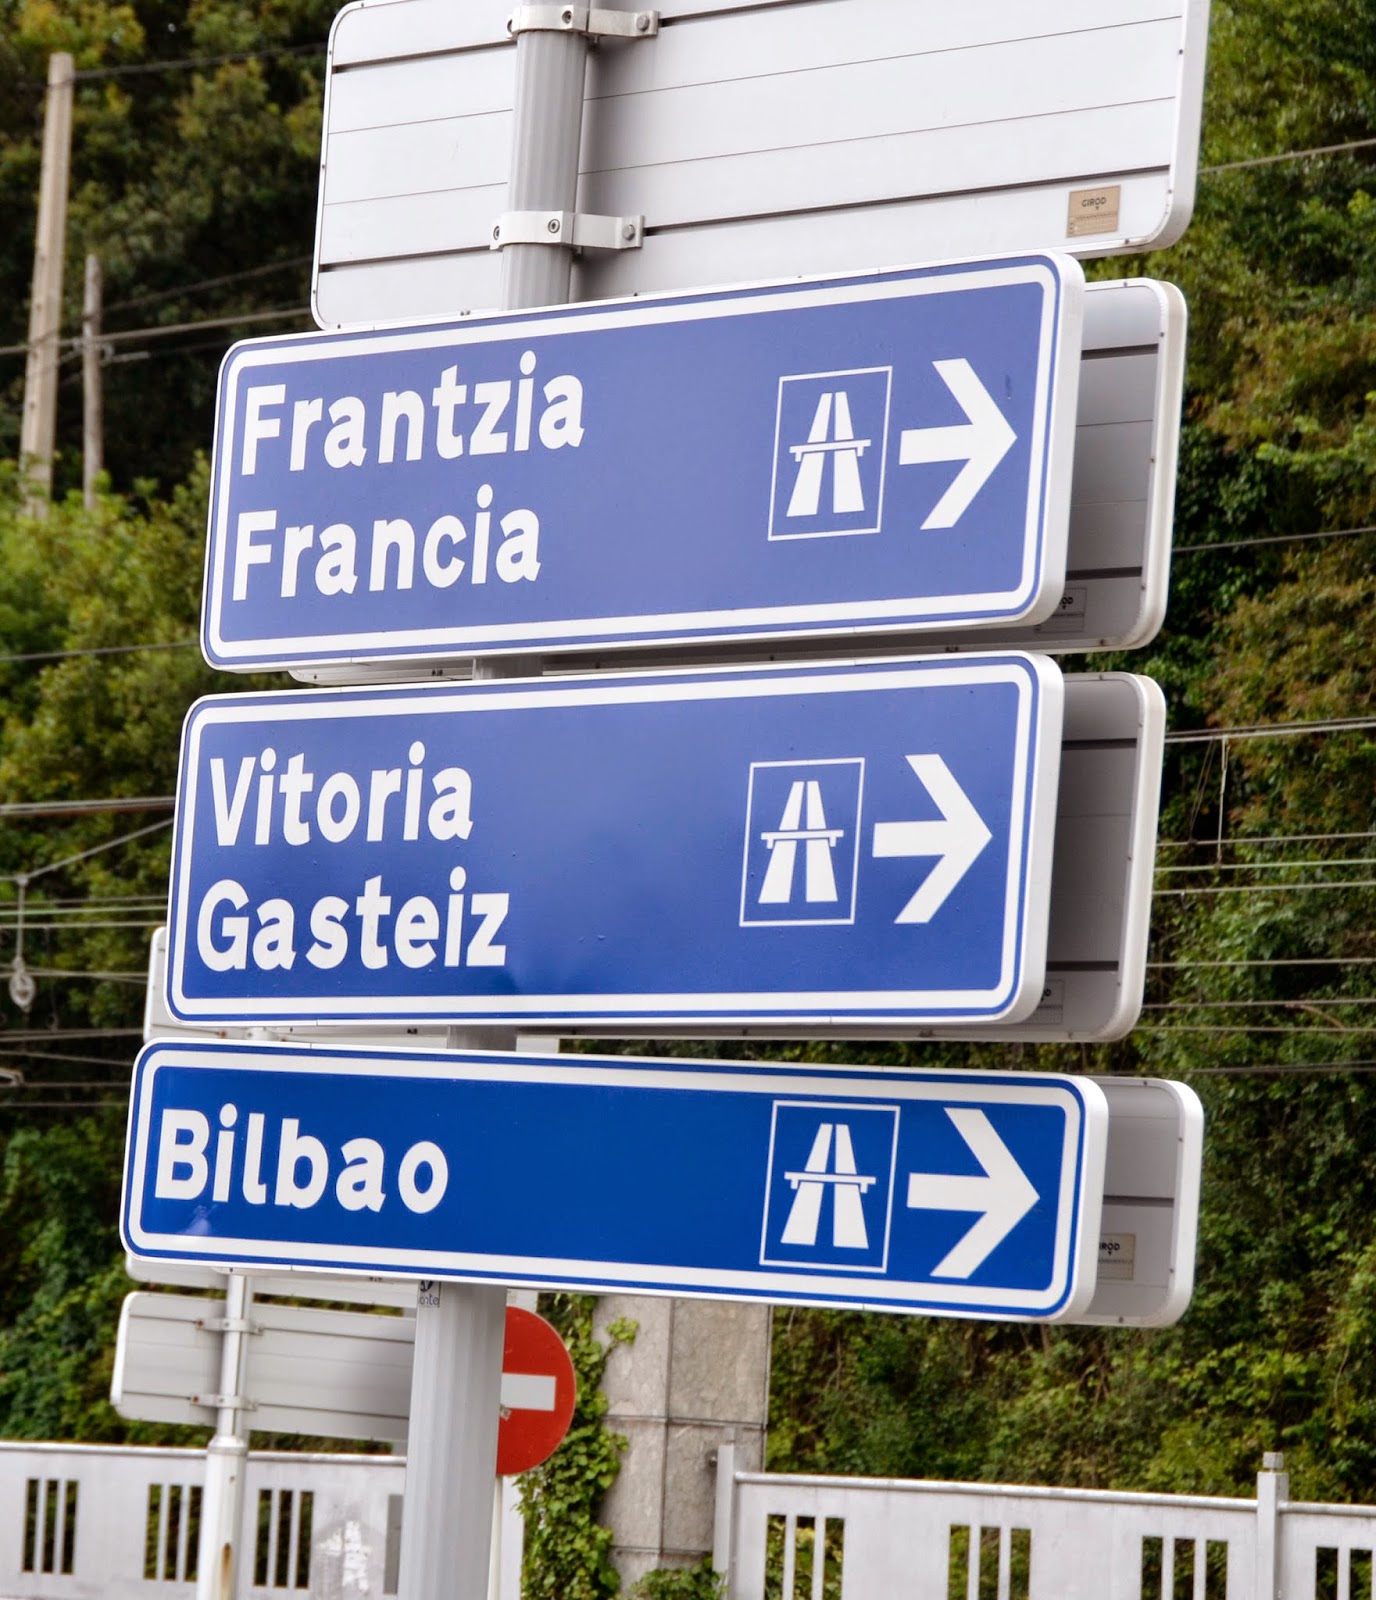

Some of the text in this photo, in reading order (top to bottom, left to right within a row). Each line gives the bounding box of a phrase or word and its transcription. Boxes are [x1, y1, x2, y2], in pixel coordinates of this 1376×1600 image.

[1081, 196, 1107, 208] GIROD
[241, 349, 586, 478] Frantzia
[232, 483, 541, 602] Francia
[210, 741, 474, 847] Vitoria
[197, 866, 509, 971] Gasteiz
[155, 1103, 449, 1214] Bilbao
